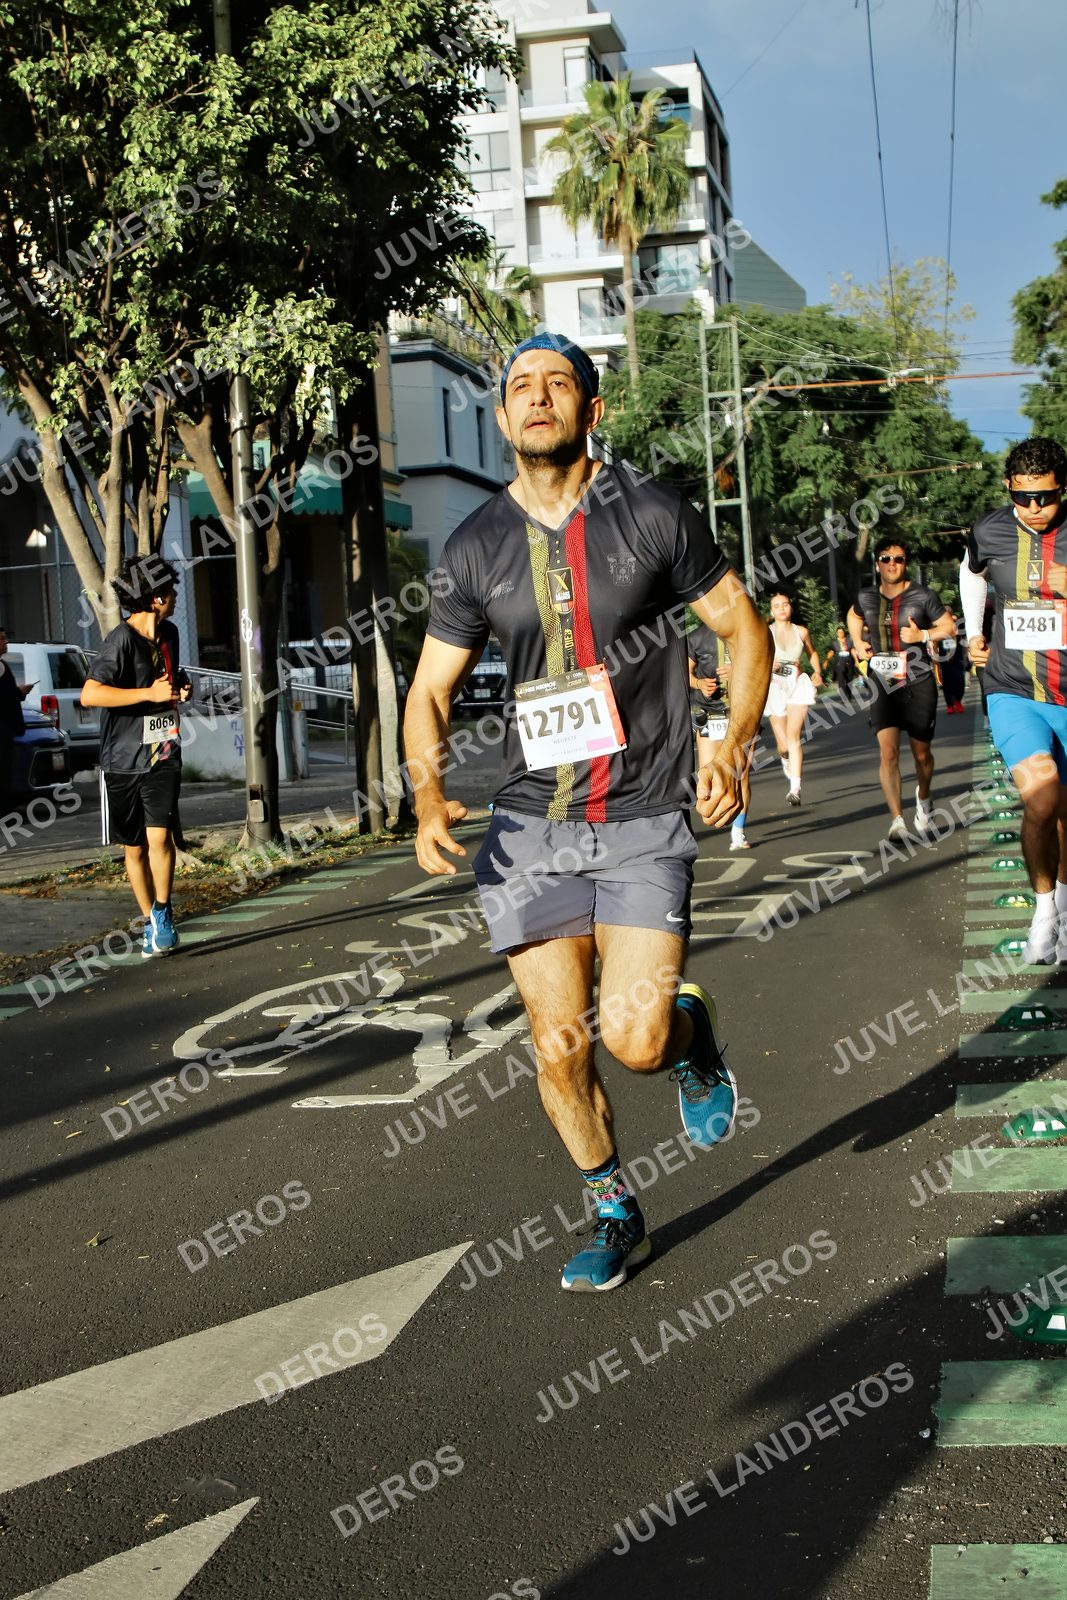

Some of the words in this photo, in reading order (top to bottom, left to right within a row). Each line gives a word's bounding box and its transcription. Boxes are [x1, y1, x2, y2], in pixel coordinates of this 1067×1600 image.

[1007, 616, 1056, 632] 12481
[875, 659, 899, 670] 9559
[149, 714, 175, 731] 8068
[518, 697, 601, 740] 12791
